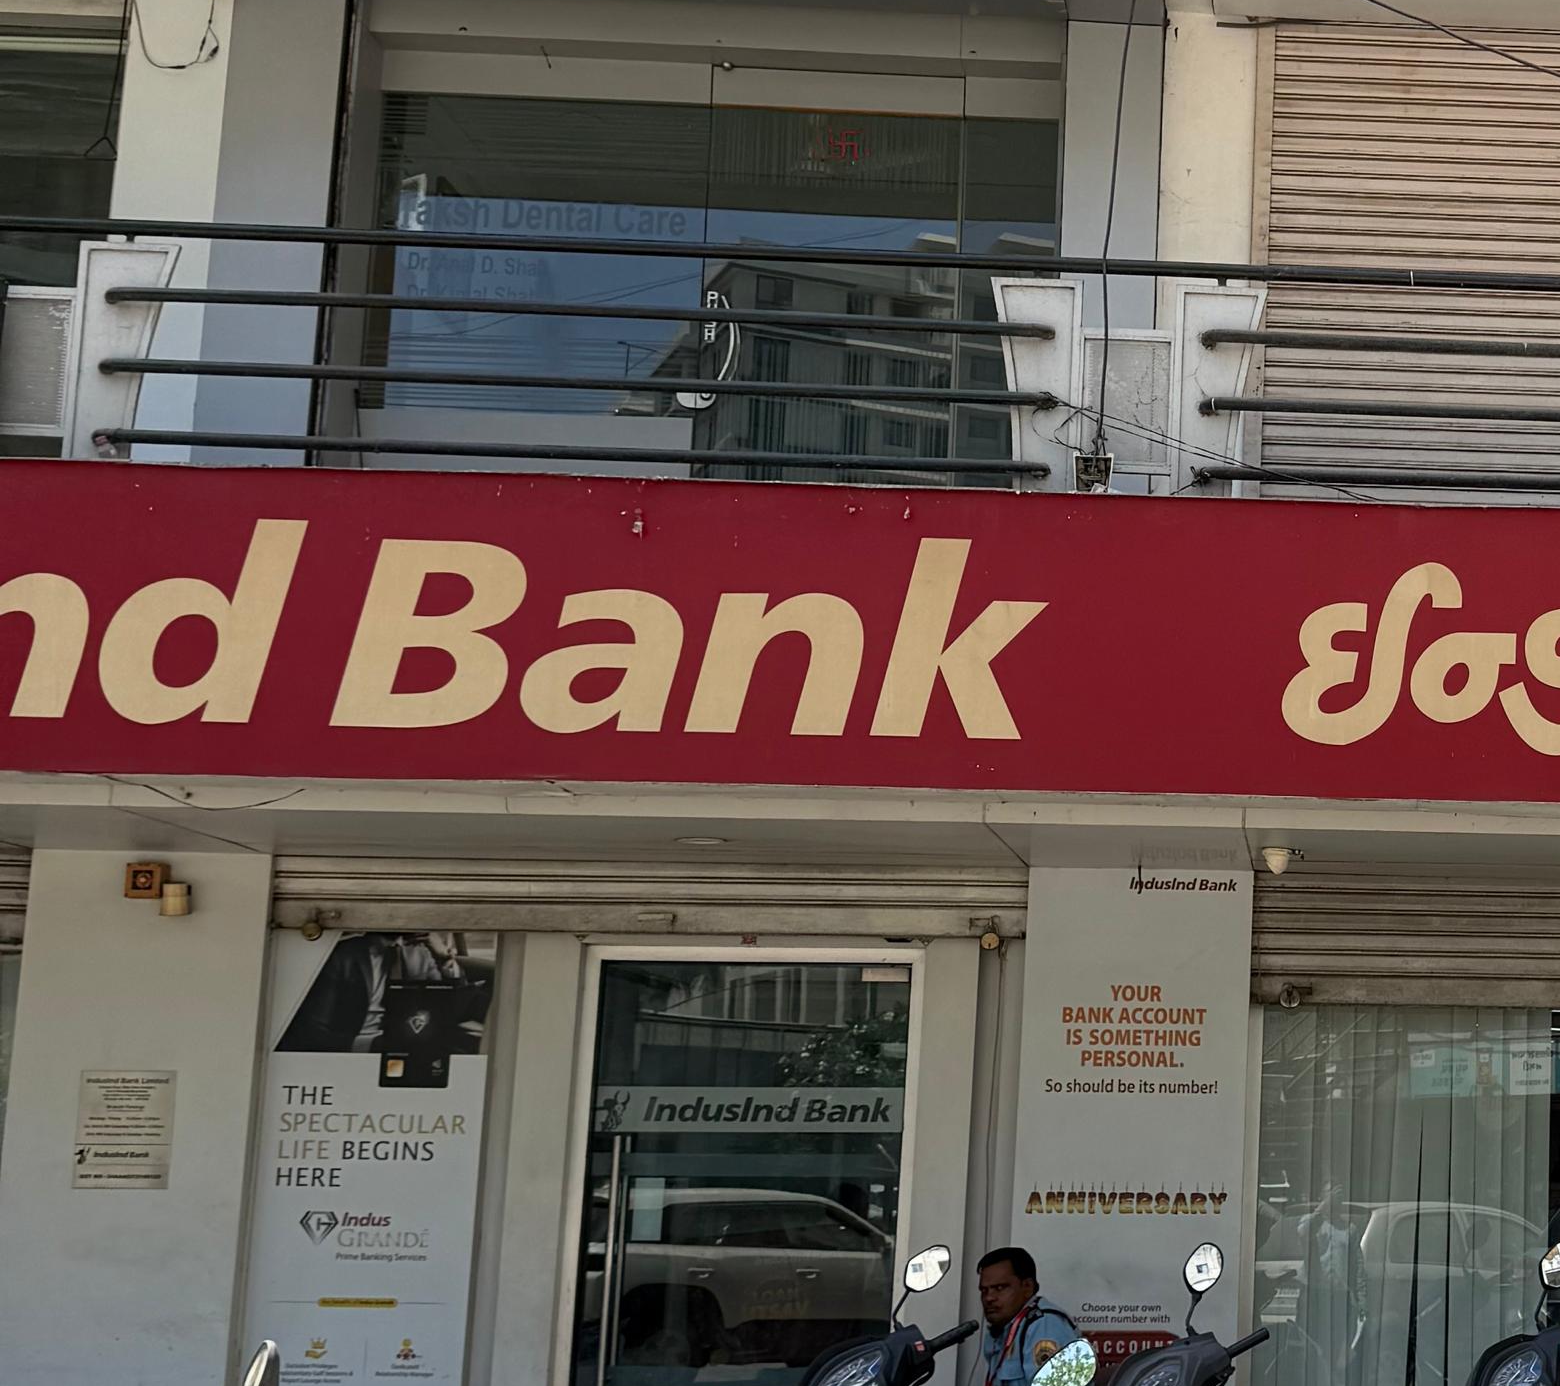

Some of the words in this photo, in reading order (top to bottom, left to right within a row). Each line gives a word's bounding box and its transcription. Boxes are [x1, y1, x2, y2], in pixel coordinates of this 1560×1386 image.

[614, 203, 687, 236] Care
[329, 538, 1049, 740] Bank
[1129, 876, 1197, 891] IndusInd
[1199, 878, 1237, 892] Bank
[1110, 985, 1161, 1002] YOUR
[1062, 1007, 1114, 1024] BANK
[1118, 1008, 1207, 1025] ACCOUNT
[1066, 1029, 1083, 1046] IS
[1089, 1029, 1201, 1047] SOMETHING
[1081, 1050, 1185, 1068] PERSONAL.
[282, 1085, 334, 1105] THE
[1045, 1079, 1062, 1093] So
[1066, 1078, 1114, 1093] should
[1118, 1079, 1135, 1094] be
[1139, 1079, 1155, 1094] its
[1159, 1079, 1218, 1094] number!
[643, 1096, 800, 1123] IndusInd
[803, 1097, 891, 1124] Bank
[279, 1112, 466, 1134] SPECTACULAR
[277, 1139, 330, 1160] LIFE
[341, 1140, 434, 1161] BEGINS
[275, 1167, 342, 1187] HERE
[1025, 1190, 1228, 1215] ANNIVERSARY
[341, 1212, 391, 1227] Indus
[335, 1252, 358, 1261] Prime
[361, 1252, 392, 1262] Banking
[395, 1253, 427, 1261] Services
[1081, 1303, 1116, 1312] Choose
[1118, 1304, 1139, 1314] your
[1141, 1304, 1162, 1312] own
[1111, 1315, 1148, 1323] number
[1150, 1314, 1170, 1324] with
